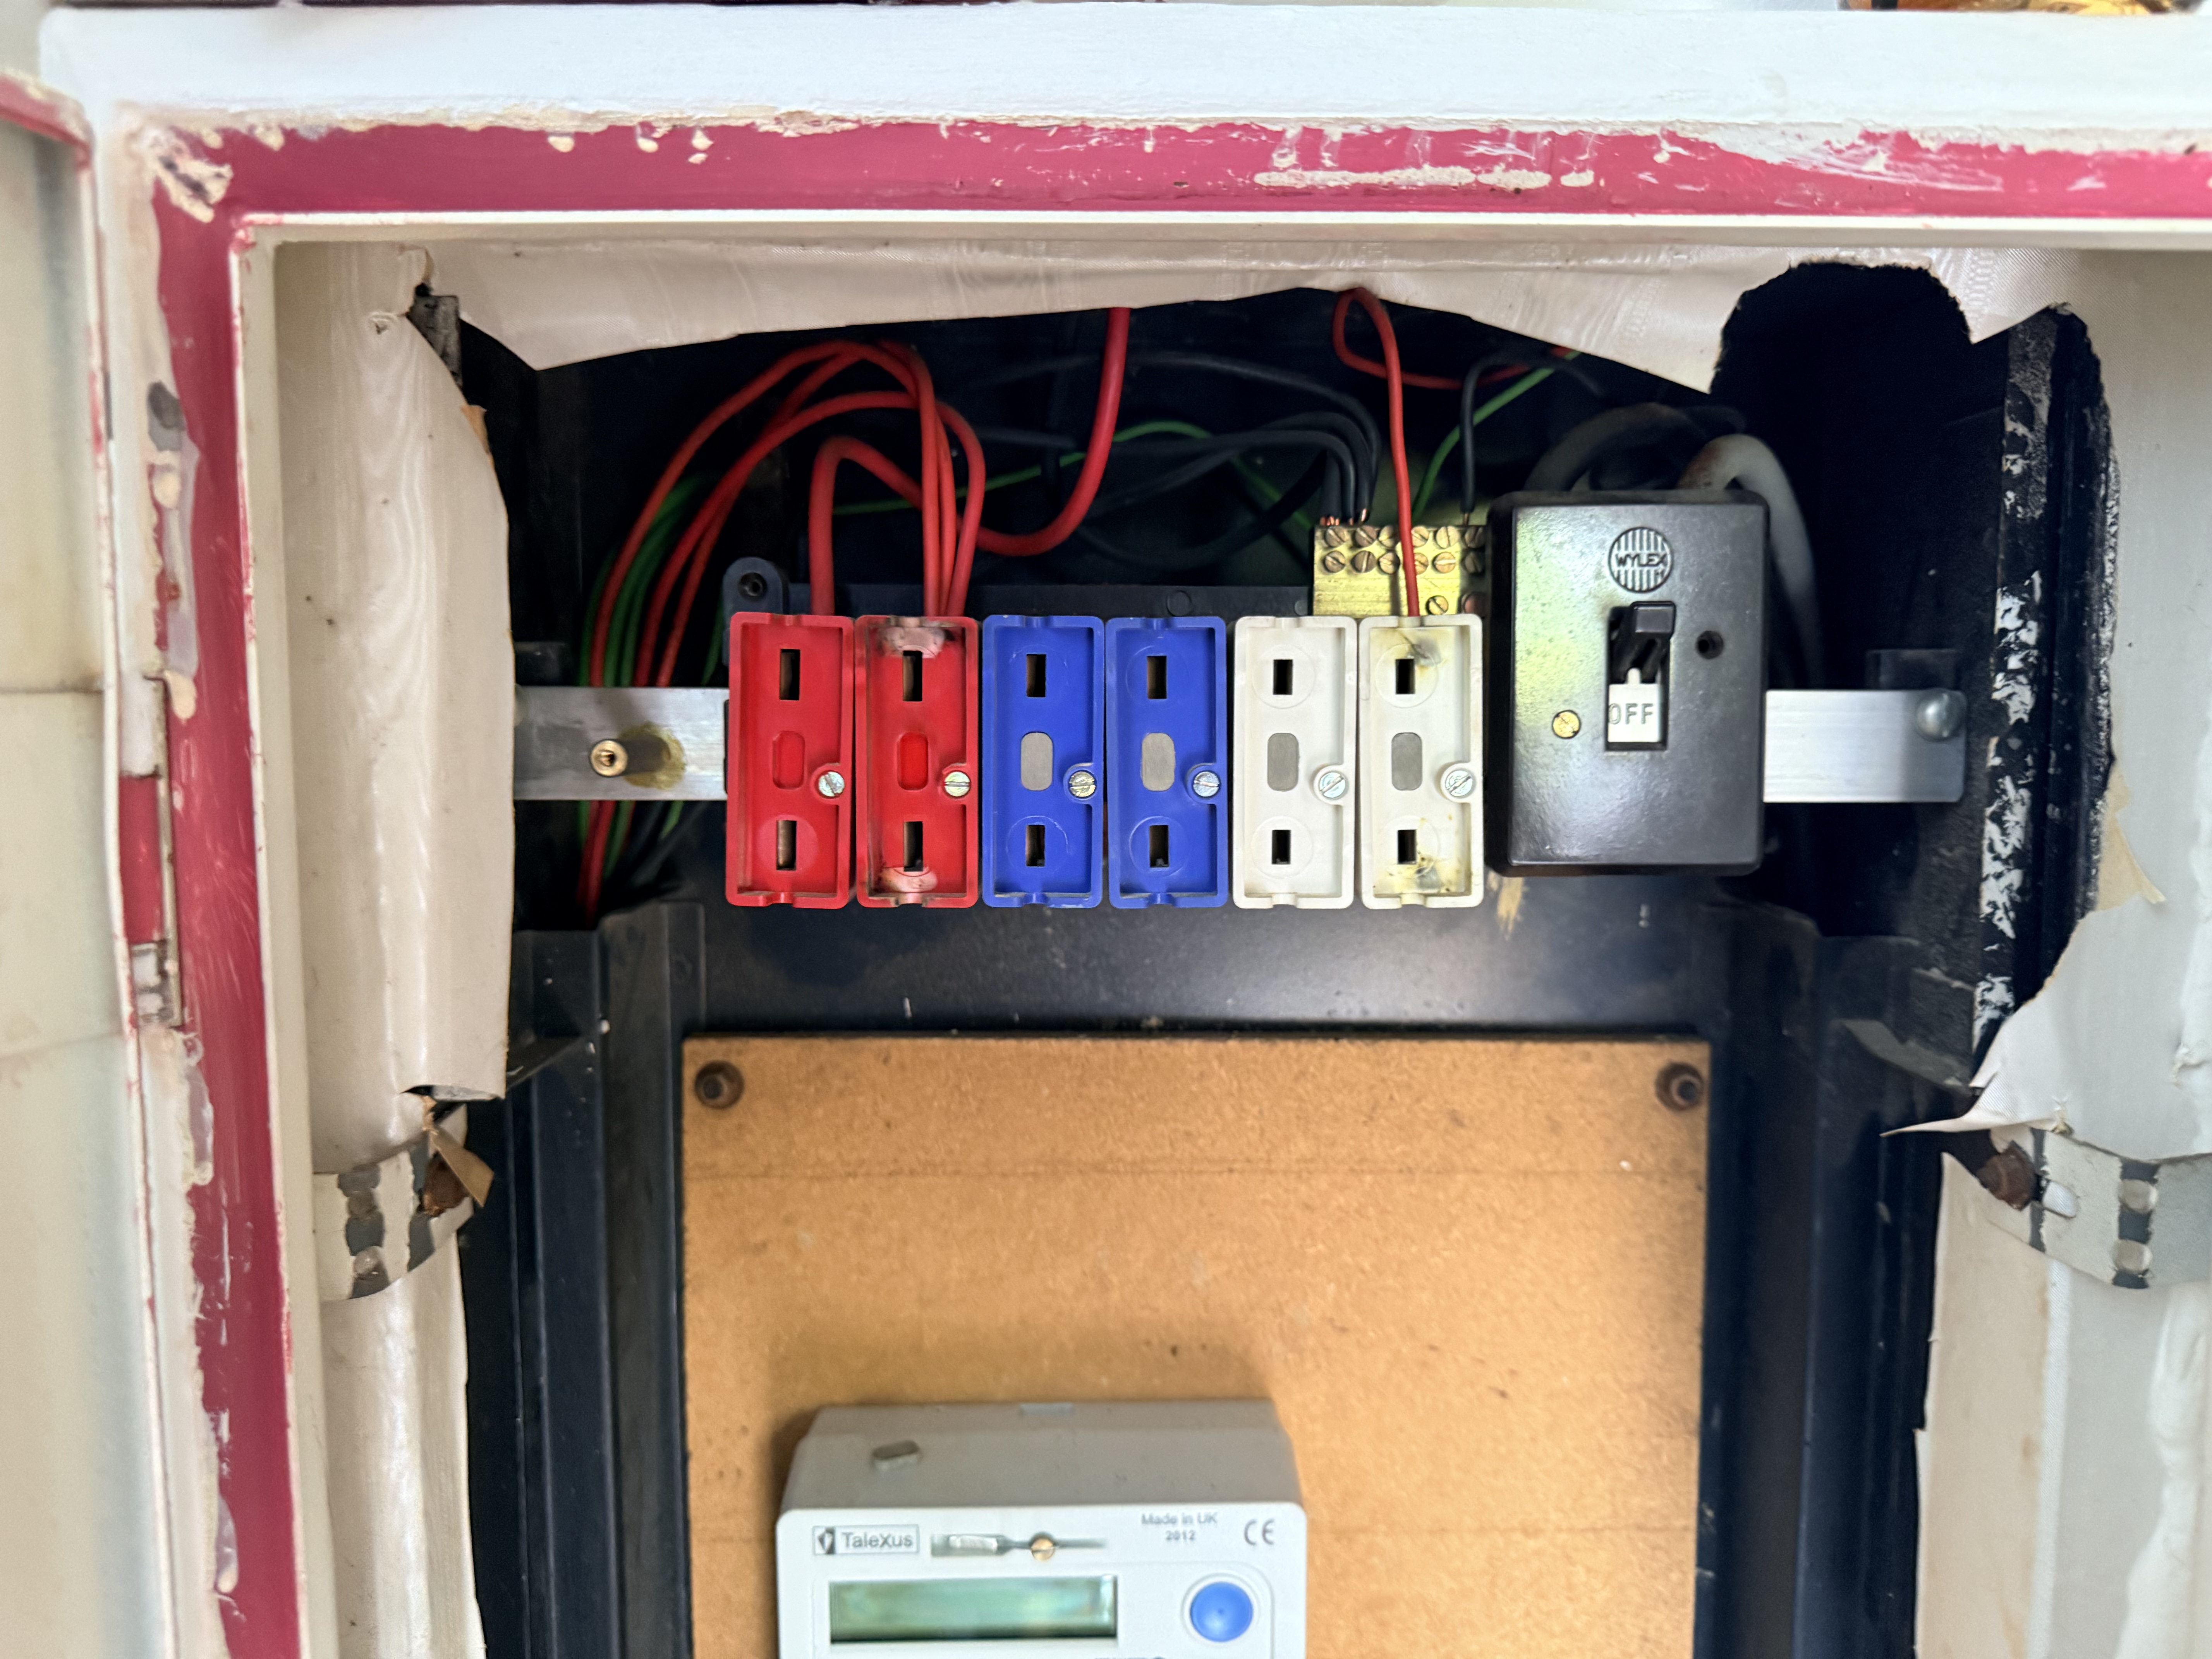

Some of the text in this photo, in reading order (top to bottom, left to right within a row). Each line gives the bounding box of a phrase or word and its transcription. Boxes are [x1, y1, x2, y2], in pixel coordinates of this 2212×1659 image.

[1615, 553, 1667, 567] WYLEX
[1609, 703, 1654, 725] OFF
[1142, 1512, 1217, 1524] Made in UK
[1165, 1530, 1196, 1541] 2012
[1243, 1518, 1274, 1546] CE
